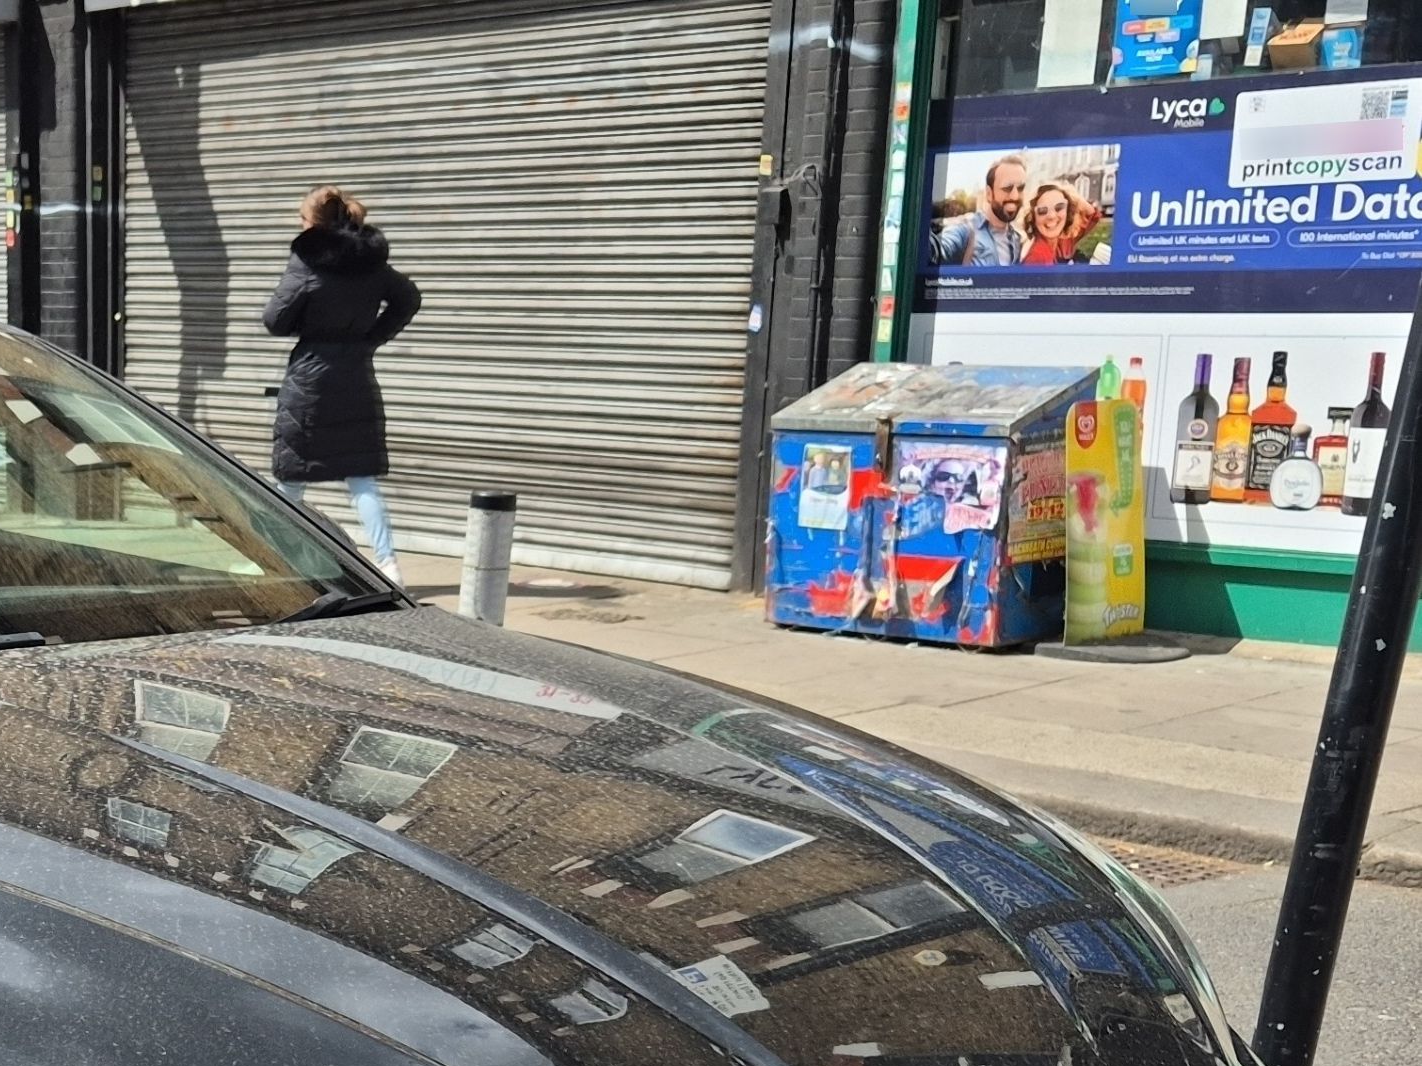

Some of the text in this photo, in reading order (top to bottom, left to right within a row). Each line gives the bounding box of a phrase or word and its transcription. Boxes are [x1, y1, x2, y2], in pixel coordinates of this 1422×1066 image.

[1150, 97, 1209, 124] Lyca
[1173, 117, 1205, 128] Mobile
[1242, 154, 1403, 182] printcopyscan
[1131, 184, 1320, 228] Unlimited
[1317, 230, 1376, 242] International
